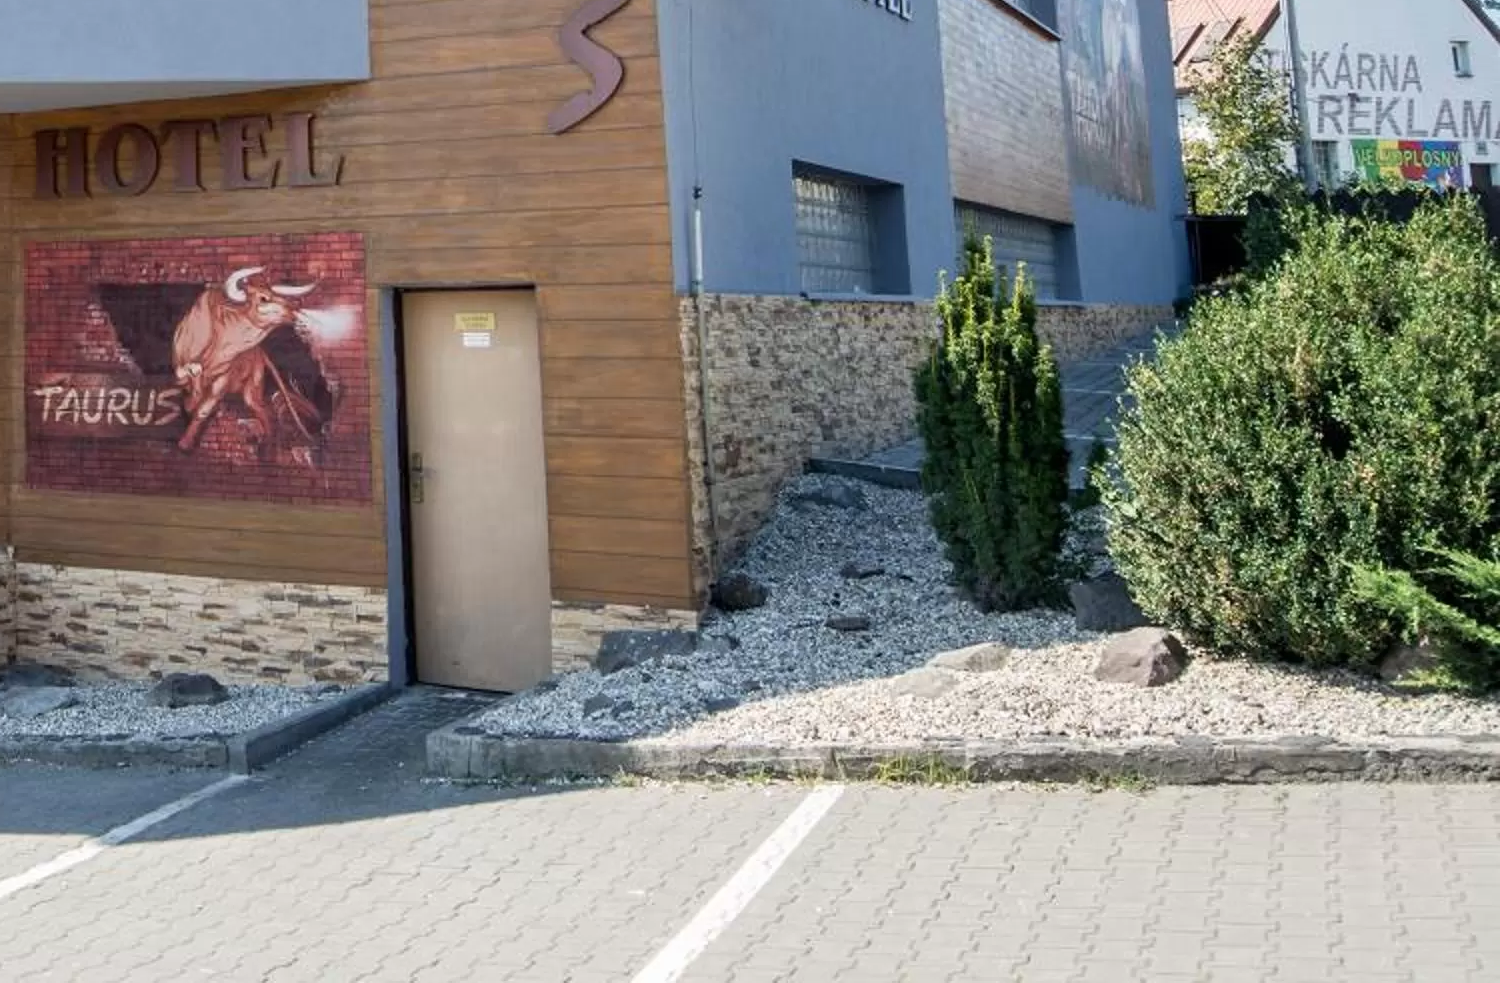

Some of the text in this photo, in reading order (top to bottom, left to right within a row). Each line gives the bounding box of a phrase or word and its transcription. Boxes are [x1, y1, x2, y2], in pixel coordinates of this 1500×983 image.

[1316, 93, 1500, 140] REKLAM
[33, 111, 346, 201] HOTEL
[33, 384, 182, 427] TAURUS
